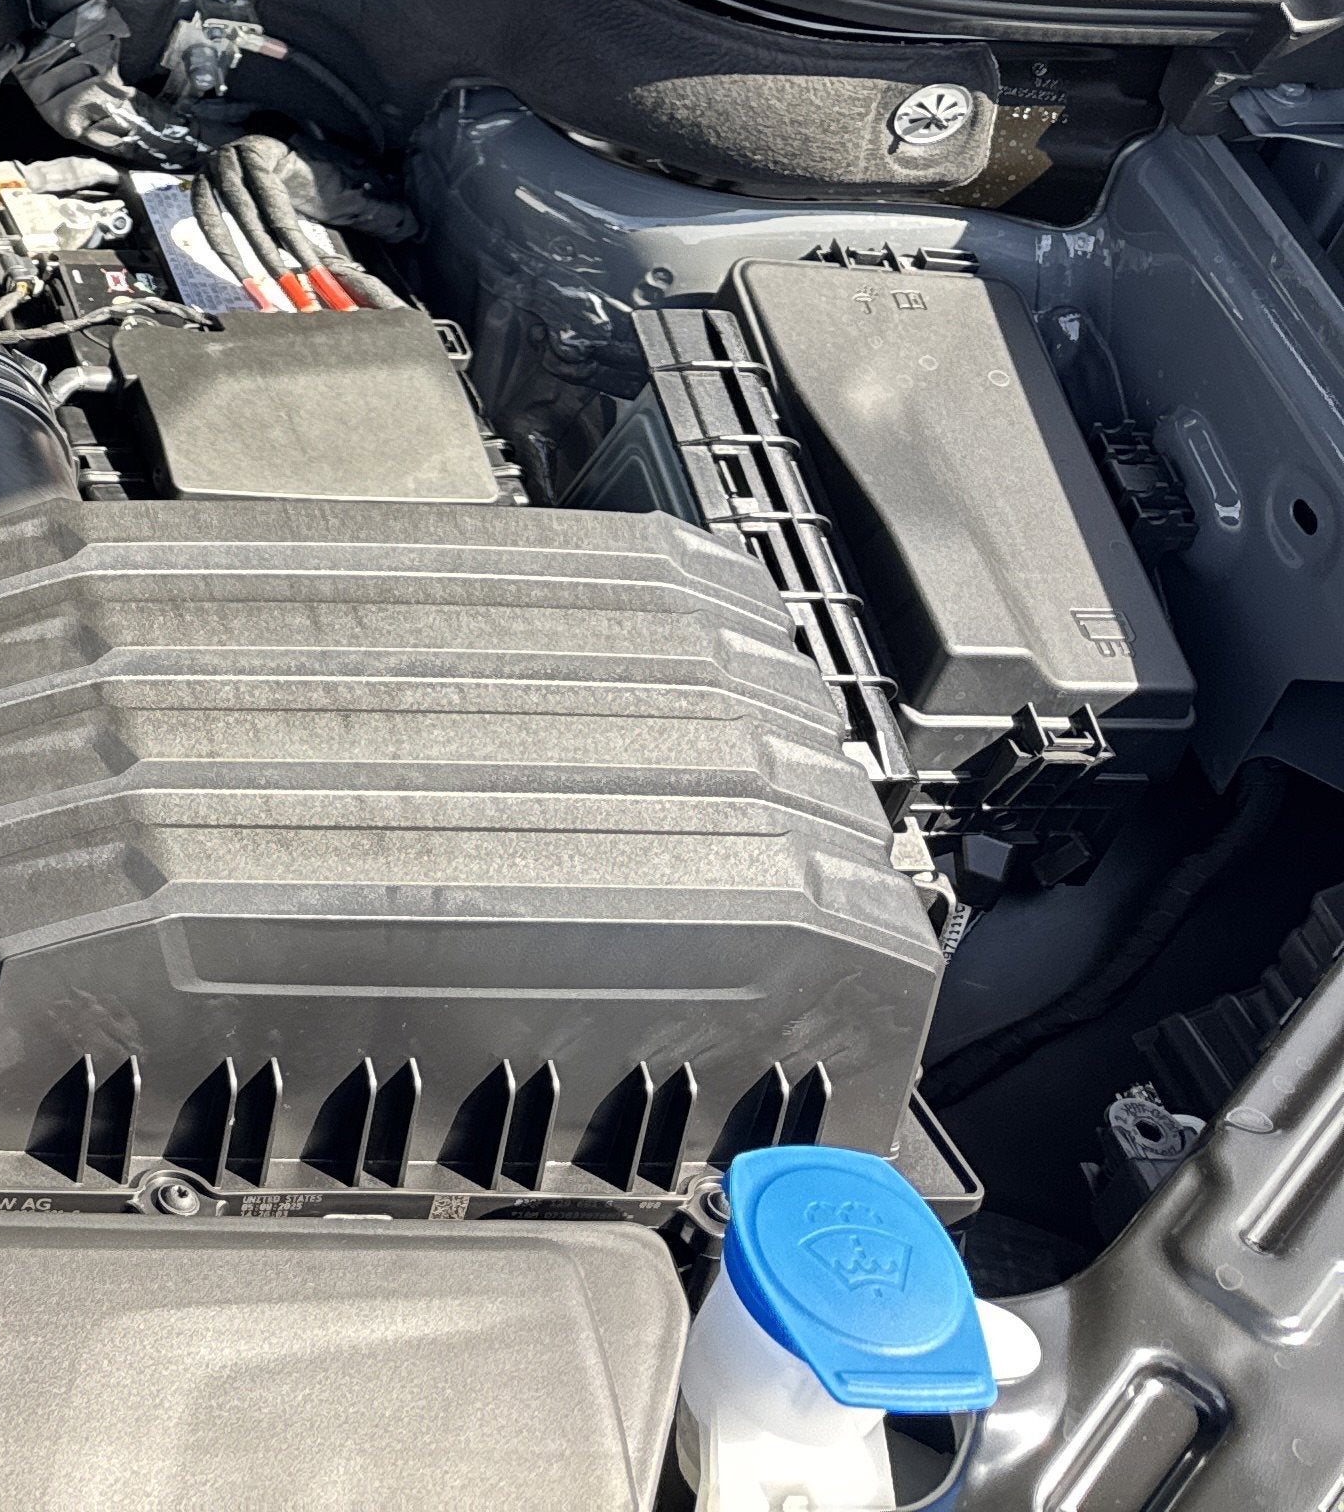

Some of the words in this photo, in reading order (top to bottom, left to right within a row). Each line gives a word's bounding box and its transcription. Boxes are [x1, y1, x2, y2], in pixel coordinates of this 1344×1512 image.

[21, 1197, 52, 1210] AG
[242, 1195, 281, 1203] UNITED
[285, 1194, 323, 1203] STATES
